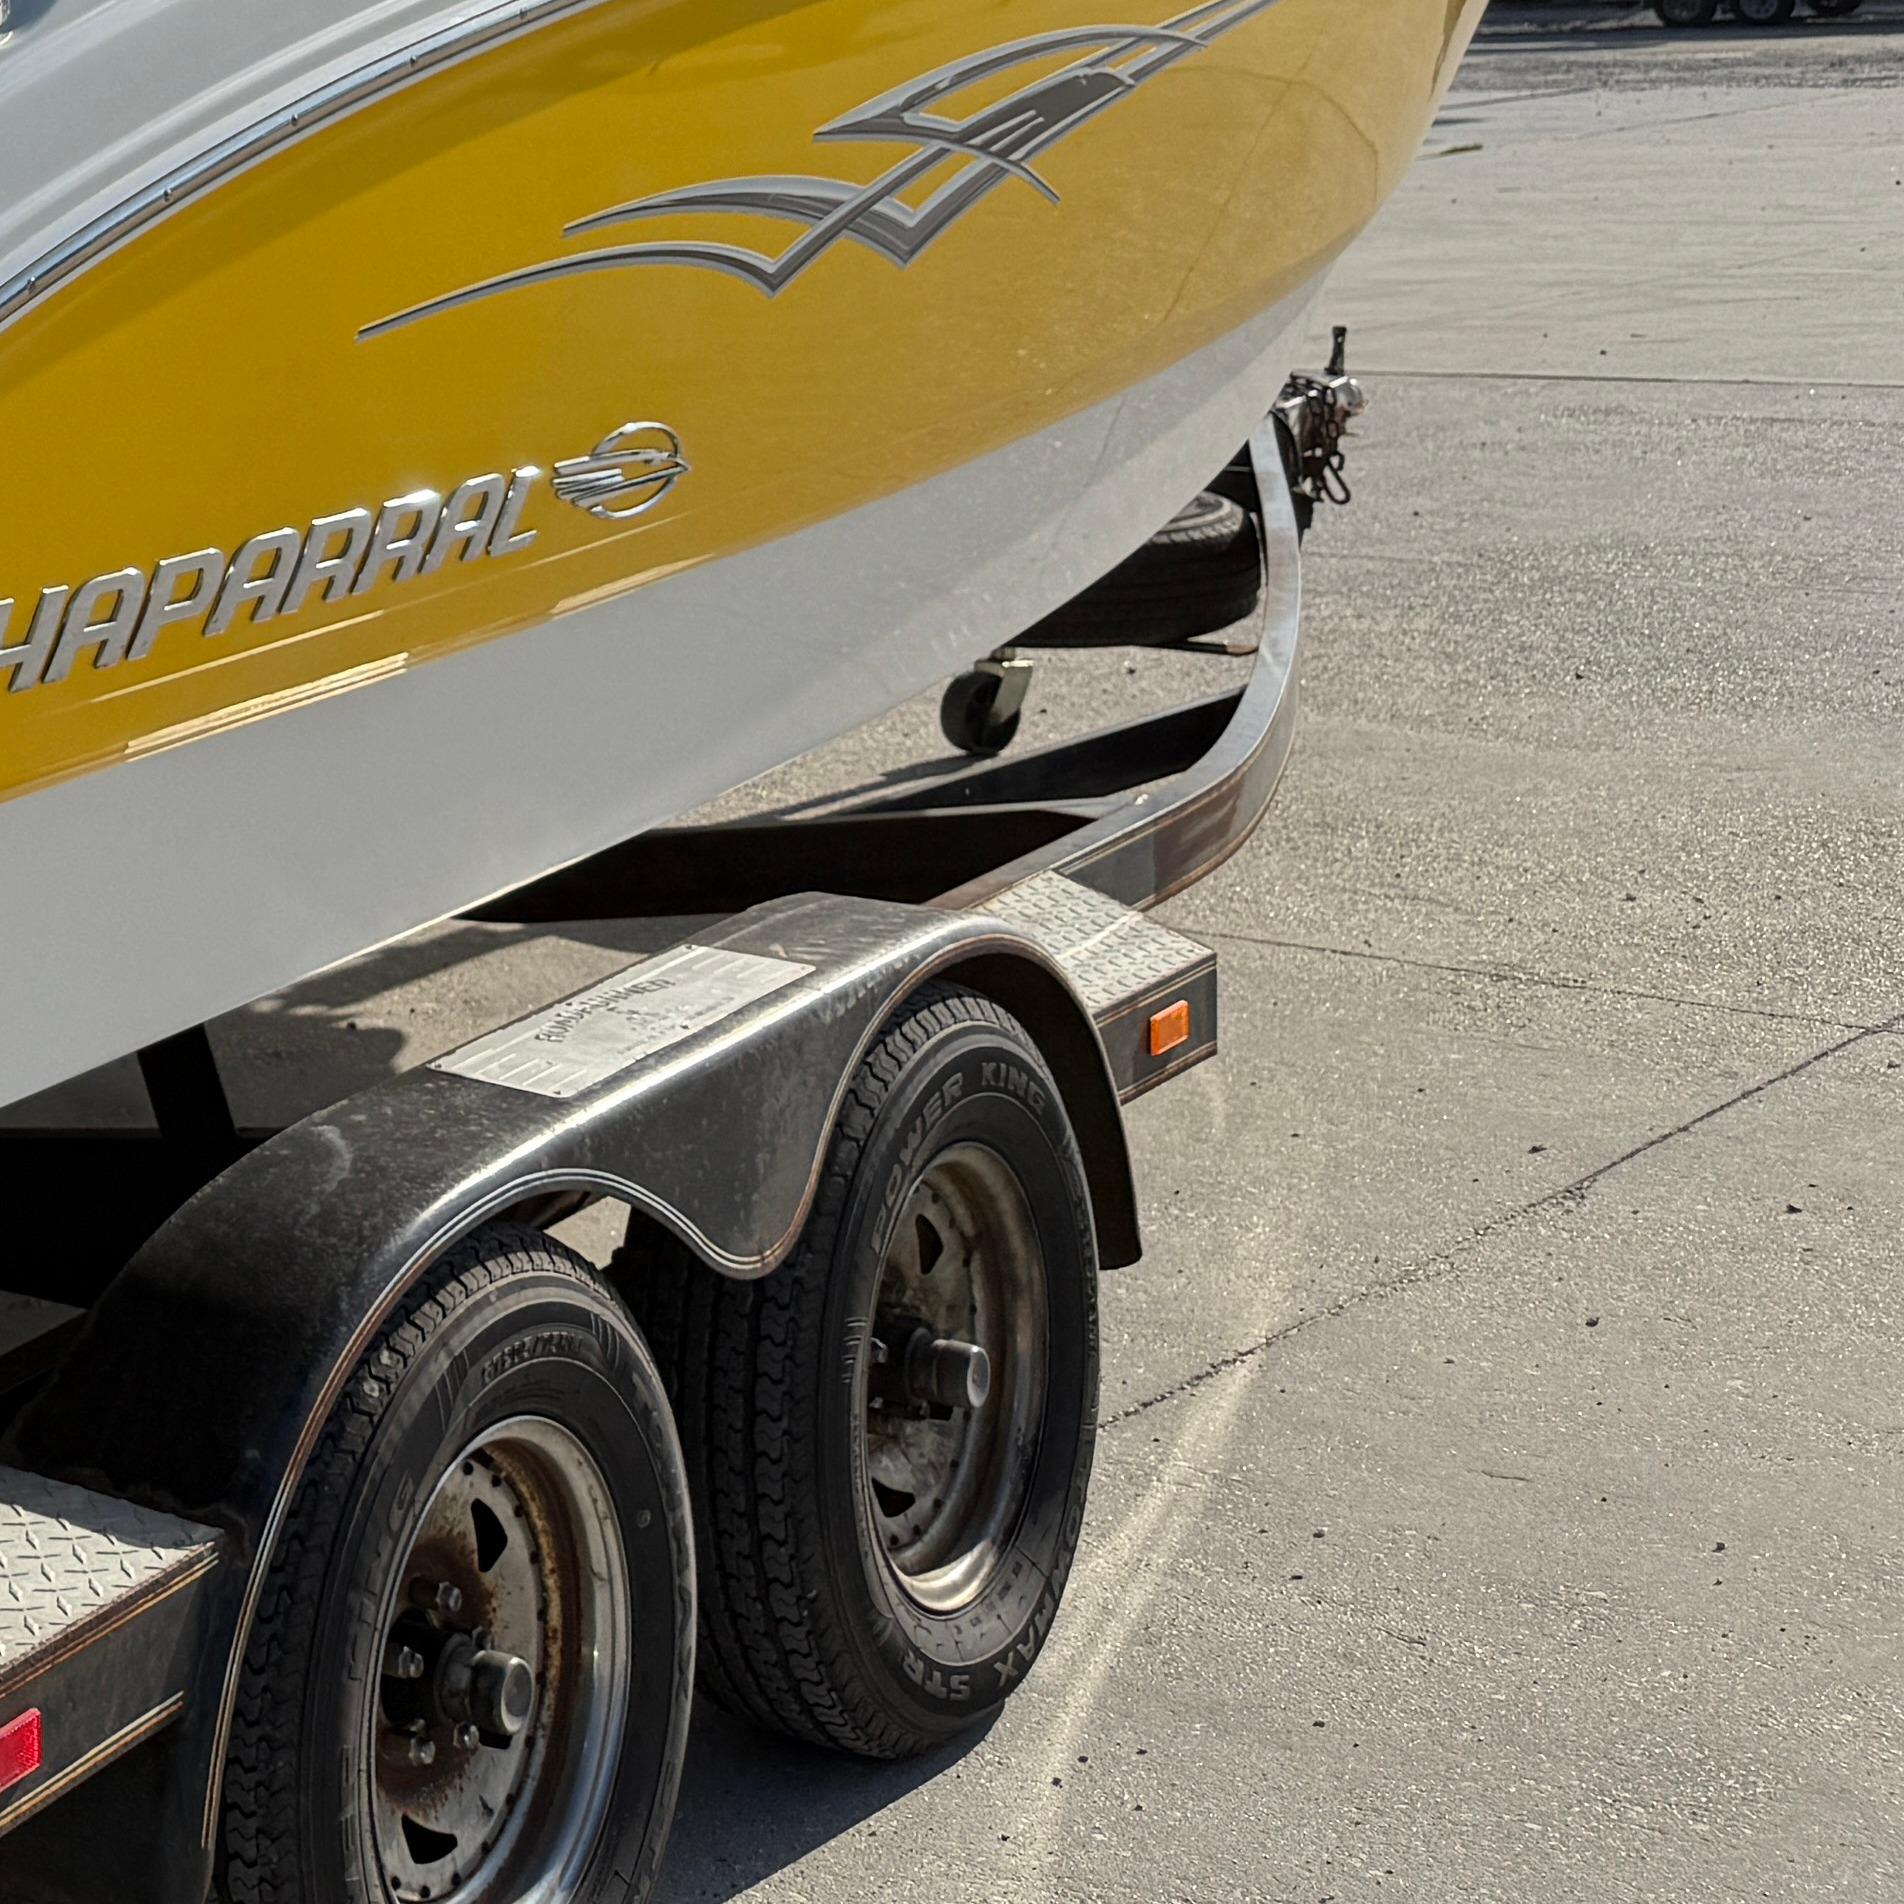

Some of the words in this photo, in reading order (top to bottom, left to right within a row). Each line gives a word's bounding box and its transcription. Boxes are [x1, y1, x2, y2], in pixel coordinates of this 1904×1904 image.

[870, 1071, 964, 1256] POWER
[981, 1061, 1047, 1117] KING
[901, 1646, 971, 1702] STR
